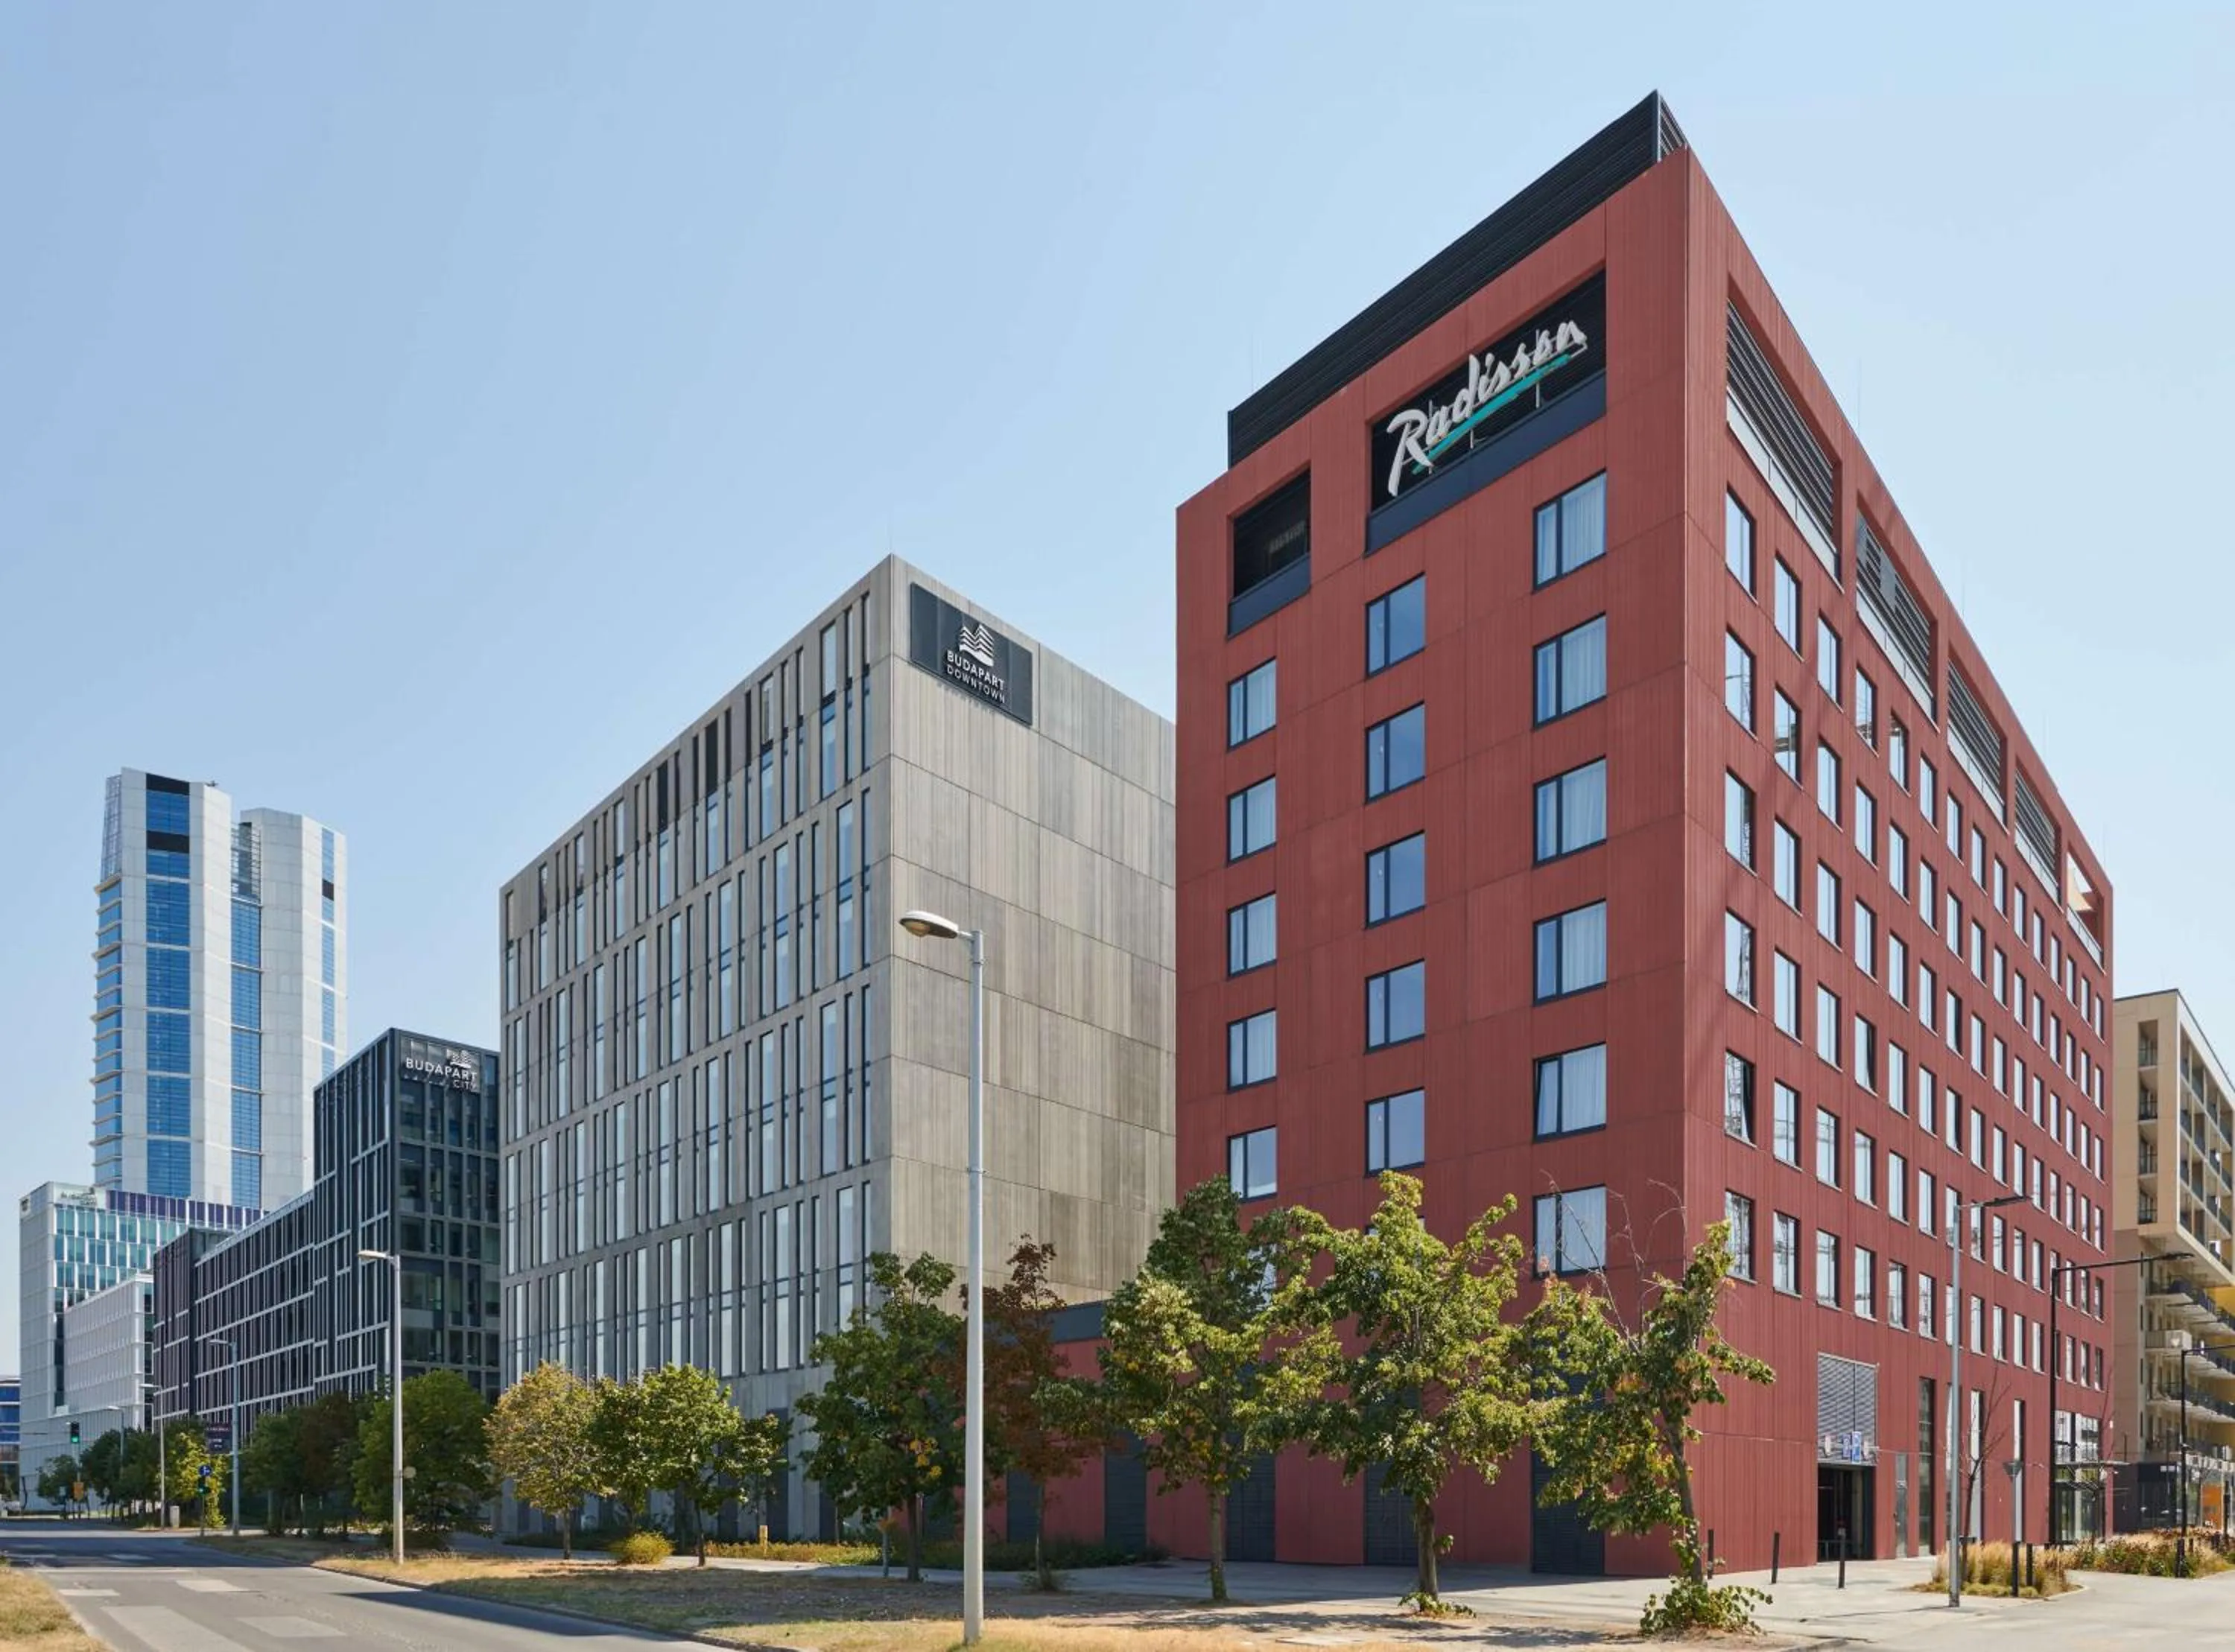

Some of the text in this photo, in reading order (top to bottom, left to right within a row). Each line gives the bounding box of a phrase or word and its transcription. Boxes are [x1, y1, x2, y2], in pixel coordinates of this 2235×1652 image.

[1386, 320, 1588, 497] Radisson
[947, 650, 1005, 690] BUDAPART
[947, 664, 1005, 703] DOWNTOWN
[406, 1057, 478, 1080] BUDAPART
